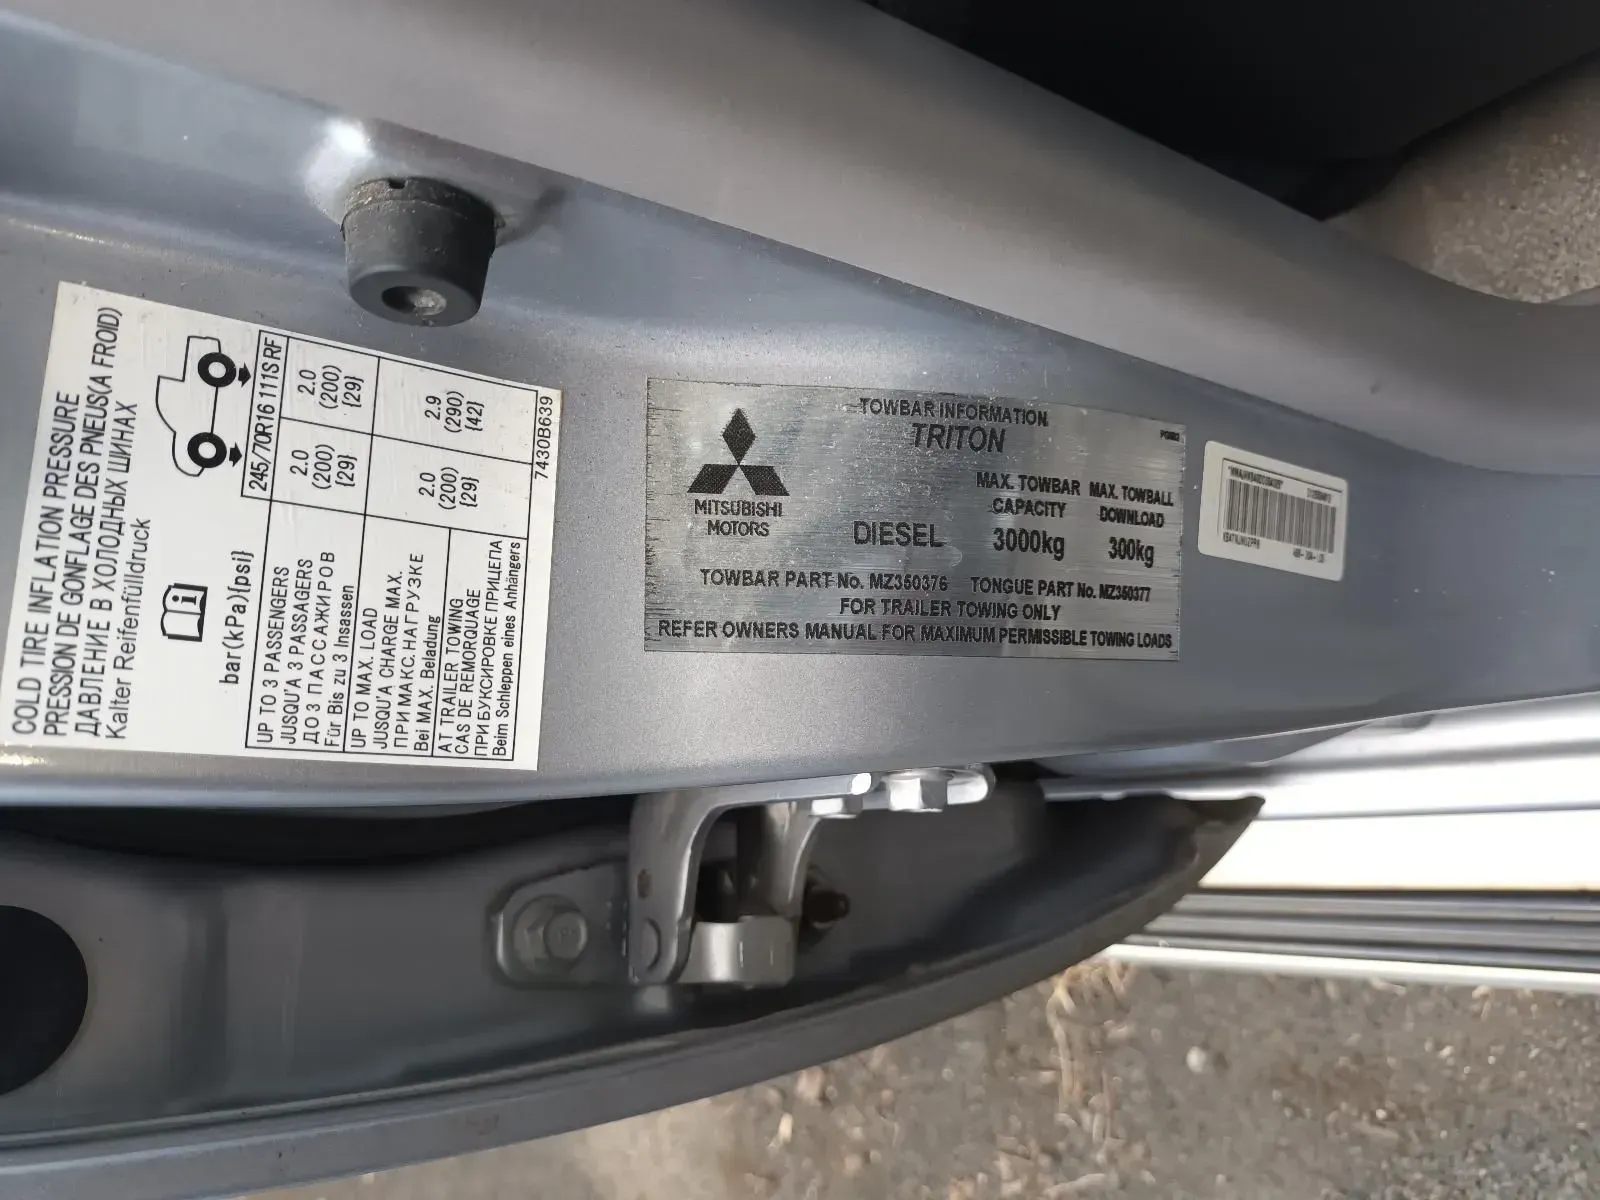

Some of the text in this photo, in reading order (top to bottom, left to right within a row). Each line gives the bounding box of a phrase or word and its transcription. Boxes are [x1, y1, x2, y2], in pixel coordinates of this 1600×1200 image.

[91, 307, 123, 369] FROID)
[297, 369, 317, 396] 2.0
[318, 364, 343, 410] (200)
[248, 336, 283, 492] 245/70R16 111S RF
[424, 395, 442, 421] 2.9
[443, 390, 465, 434] (290)
[859, 397, 1049, 427] TOWBAR INFORMATION
[534, 395, 553, 480] 7430B639
[912, 423, 1005, 452] TRITON
[73, 461, 101, 500] DES
[289, 449, 310, 477] 2.0
[311, 443, 336, 490] (200)
[418, 472, 437, 498] 2.0
[437, 466, 460, 511] (200)
[976, 472, 1081, 496] MAX. TOWBAR
[1089, 481, 1174, 507] MAX. TOWBALL
[694, 499, 783, 517] MITSUBISHI
[992, 498, 1067, 518] CAPACITY
[1100, 506, 1165, 528] DOWNLOAD
[707, 520, 770, 537] MOTORS
[853, 521, 944, 548] DIESEL
[993, 528, 1065, 561] 3000kg
[11, 391, 80, 734] COLD TIRE INFLATION PRESSURE
[59, 503, 95, 606] GONFLAGE
[74, 400, 138, 737] ДАВЛЕНИЕ В ХОЛОДНЫХ ШИНАХ
[1108, 537, 1154, 568] 300kg
[384, 571, 403, 609] MAX.
[700, 568, 780, 587] TOWBAR
[785, 572, 834, 588] PART
[837, 573, 865, 590] No.
[971, 577, 1033, 595] TONGUE
[1038, 580, 1074, 597] PART
[1077, 582, 1097, 599] No.
[55, 611, 82, 637] DE
[288, 558, 313, 656] PASSAGERS
[307, 551, 335, 695] ПАССАЖИРОВ
[840, 597, 1061, 621] FOR TRAILER TOWING ONLY
[105, 518, 151, 739] Kalter Reifenfülldruck
[378, 614, 399, 678] CHARGE
[658, 619, 1172, 648] REFER OWNERS MANUAL FOR MAXIMUM PERMISSIBLE TOWING LOADS
[256, 566, 290, 743] UP TO 3 PASSENGERS
[287, 661, 304, 671] 3
[323, 585, 355, 747] Für Bis zu 3 Insassen
[474, 540, 503, 757] ПРИ БУКСИРОВКЕ ПРИЦЕПА
[491, 541, 522, 756] Beim Schleppen eines Anhängers
[43, 642, 77, 736] PRESSION
[350, 607, 378, 748] UP TO MAX. LOAD
[413, 614, 441, 752] Bei MAX. Beladung
[437, 598, 464, 753] AT TRAILER TOWING
[454, 588, 481, 755] CAS DE REMORQUAGE
[393, 711, 411, 748] ПРИ
